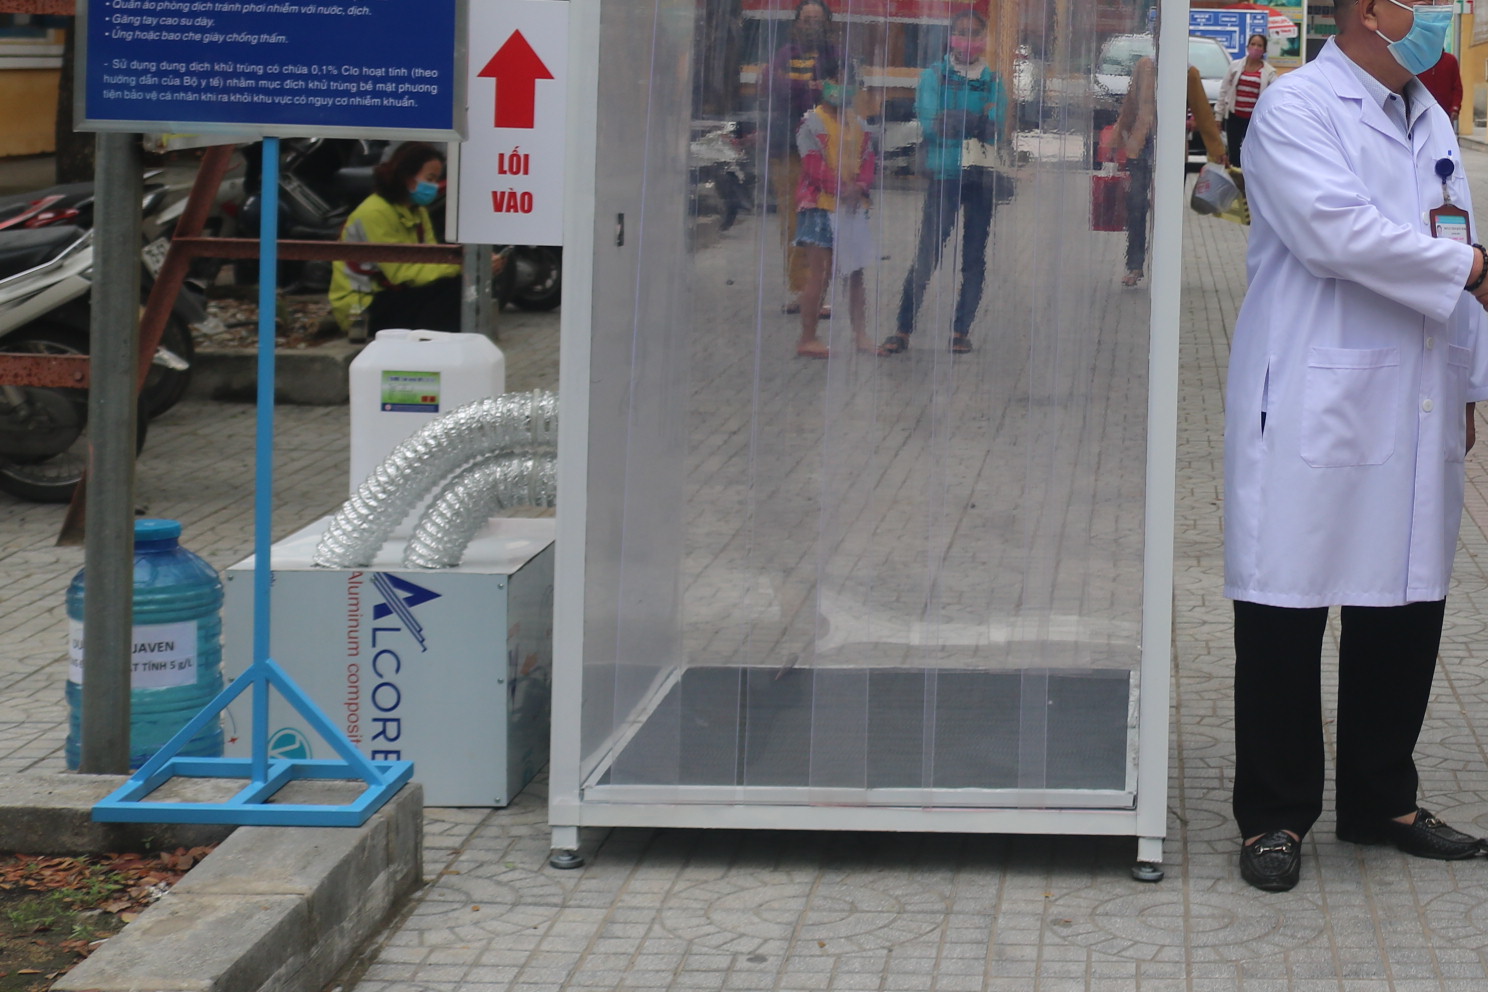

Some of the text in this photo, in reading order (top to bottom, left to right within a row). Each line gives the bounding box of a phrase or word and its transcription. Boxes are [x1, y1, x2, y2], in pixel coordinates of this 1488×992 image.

[112, 14, 140, 26] Găng
[143, 16, 158, 27] tay
[180, 18, 193, 26] su
[194, 17, 215, 28] dày.
[112, 26, 289, 45] Ủng hoặc bao che giày chống thấm.
[112, 59, 438, 78] Sử dụng dung dịch khử trùng có chứa 0,1% Clo hoạt tính (theo
[103, 74, 438, 94] hướng dẫn của Bộ y tế) nhằm mục đích khử trùng bề mặt phương
[103, 90, 418, 107] tiện bảo vệ cá nhân khi ra khỏi khu vực có nguy cơ nhiễm khuẩn.
[498, 146, 530, 176] LỐI
[491, 188, 533, 214] VÀO
[347, 571, 363, 657] Aluminum
[132, 641, 174, 654] JAVEN
[142, 660, 167, 672] TÍNH
[171, 660, 175, 670] 5
[344, 663, 363, 749] composit
